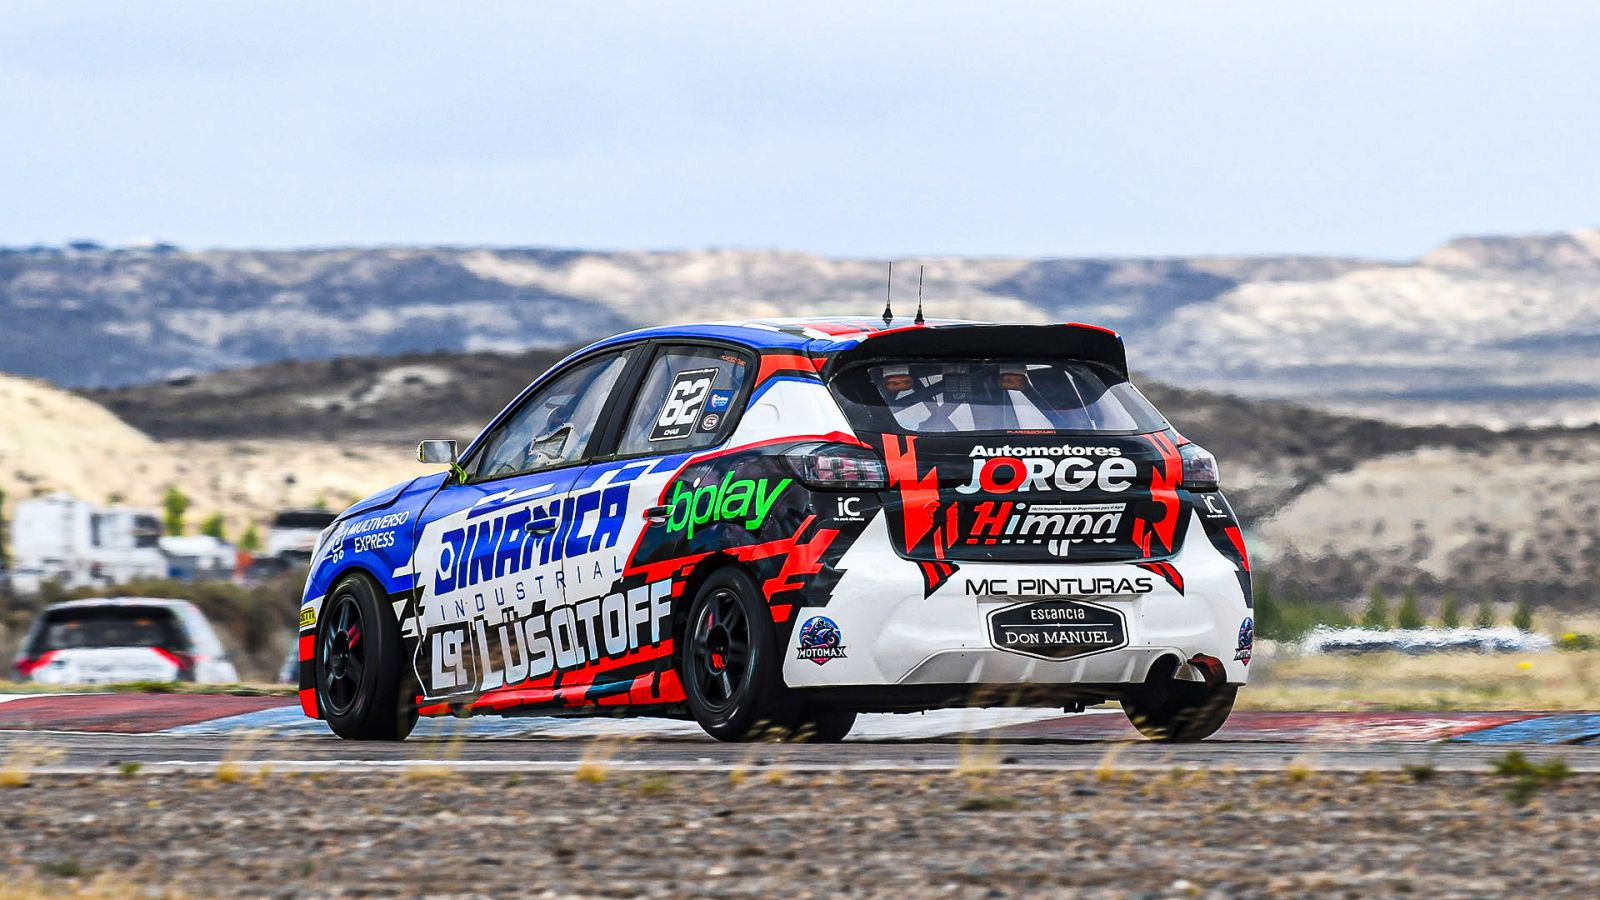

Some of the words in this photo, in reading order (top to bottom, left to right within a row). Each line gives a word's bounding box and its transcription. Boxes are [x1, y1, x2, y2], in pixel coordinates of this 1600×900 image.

[658, 378, 711, 427] 62
[968, 444, 1122, 458] Automotores
[666, 470, 793, 540] bplay
[837, 496, 861, 517] iC
[347, 511, 410, 536] MULTIVERSO
[968, 501, 1123, 556] Himpa
[354, 530, 396, 554] EXPRESS
[440, 556, 623, 620] INDUSTRIAL
[965, 578, 1008, 596] MC
[1017, 577, 1153, 595] PINTURAS
[1043, 631, 1114, 644] MANUEL
[798, 647, 844, 658] MOTOMAX
